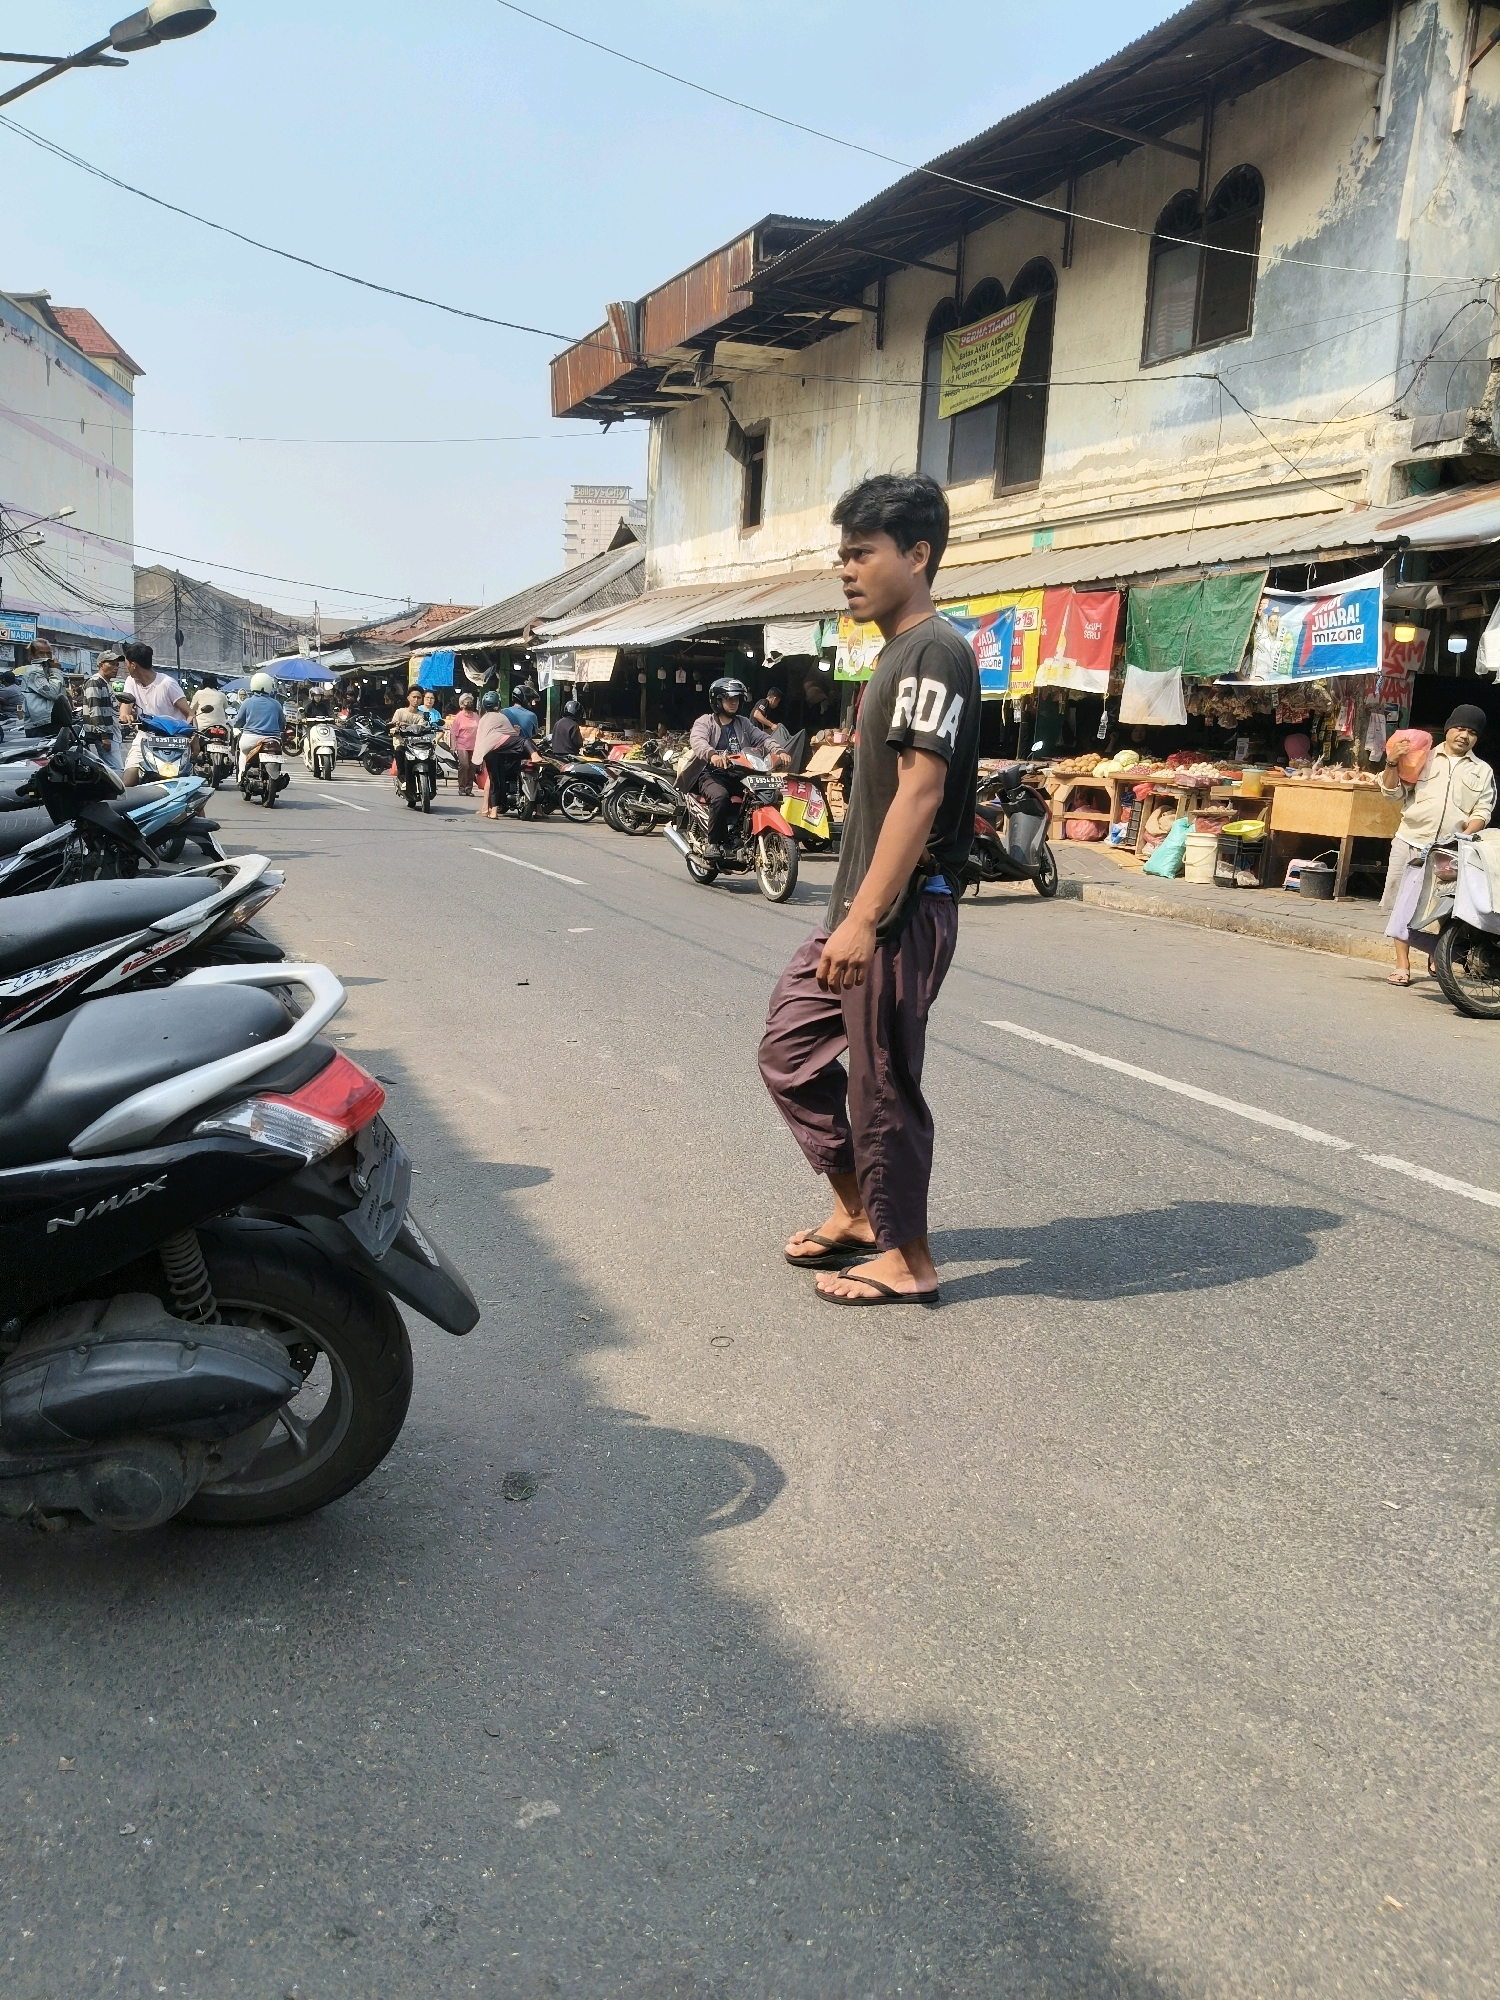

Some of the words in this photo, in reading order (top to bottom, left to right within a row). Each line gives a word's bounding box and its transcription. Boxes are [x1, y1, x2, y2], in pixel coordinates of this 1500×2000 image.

[606, 486, 627, 500] City
[1312, 603, 1360, 631] JUARA!
[10, 630, 34, 641] MASUK
[977, 629, 996, 647] JADI
[1083, 629, 1101, 640] SERU
[1313, 627, 1362, 643] mizone
[1382, 631, 1426, 663] YAM
[46, 1173, 168, 1234] NMAX
